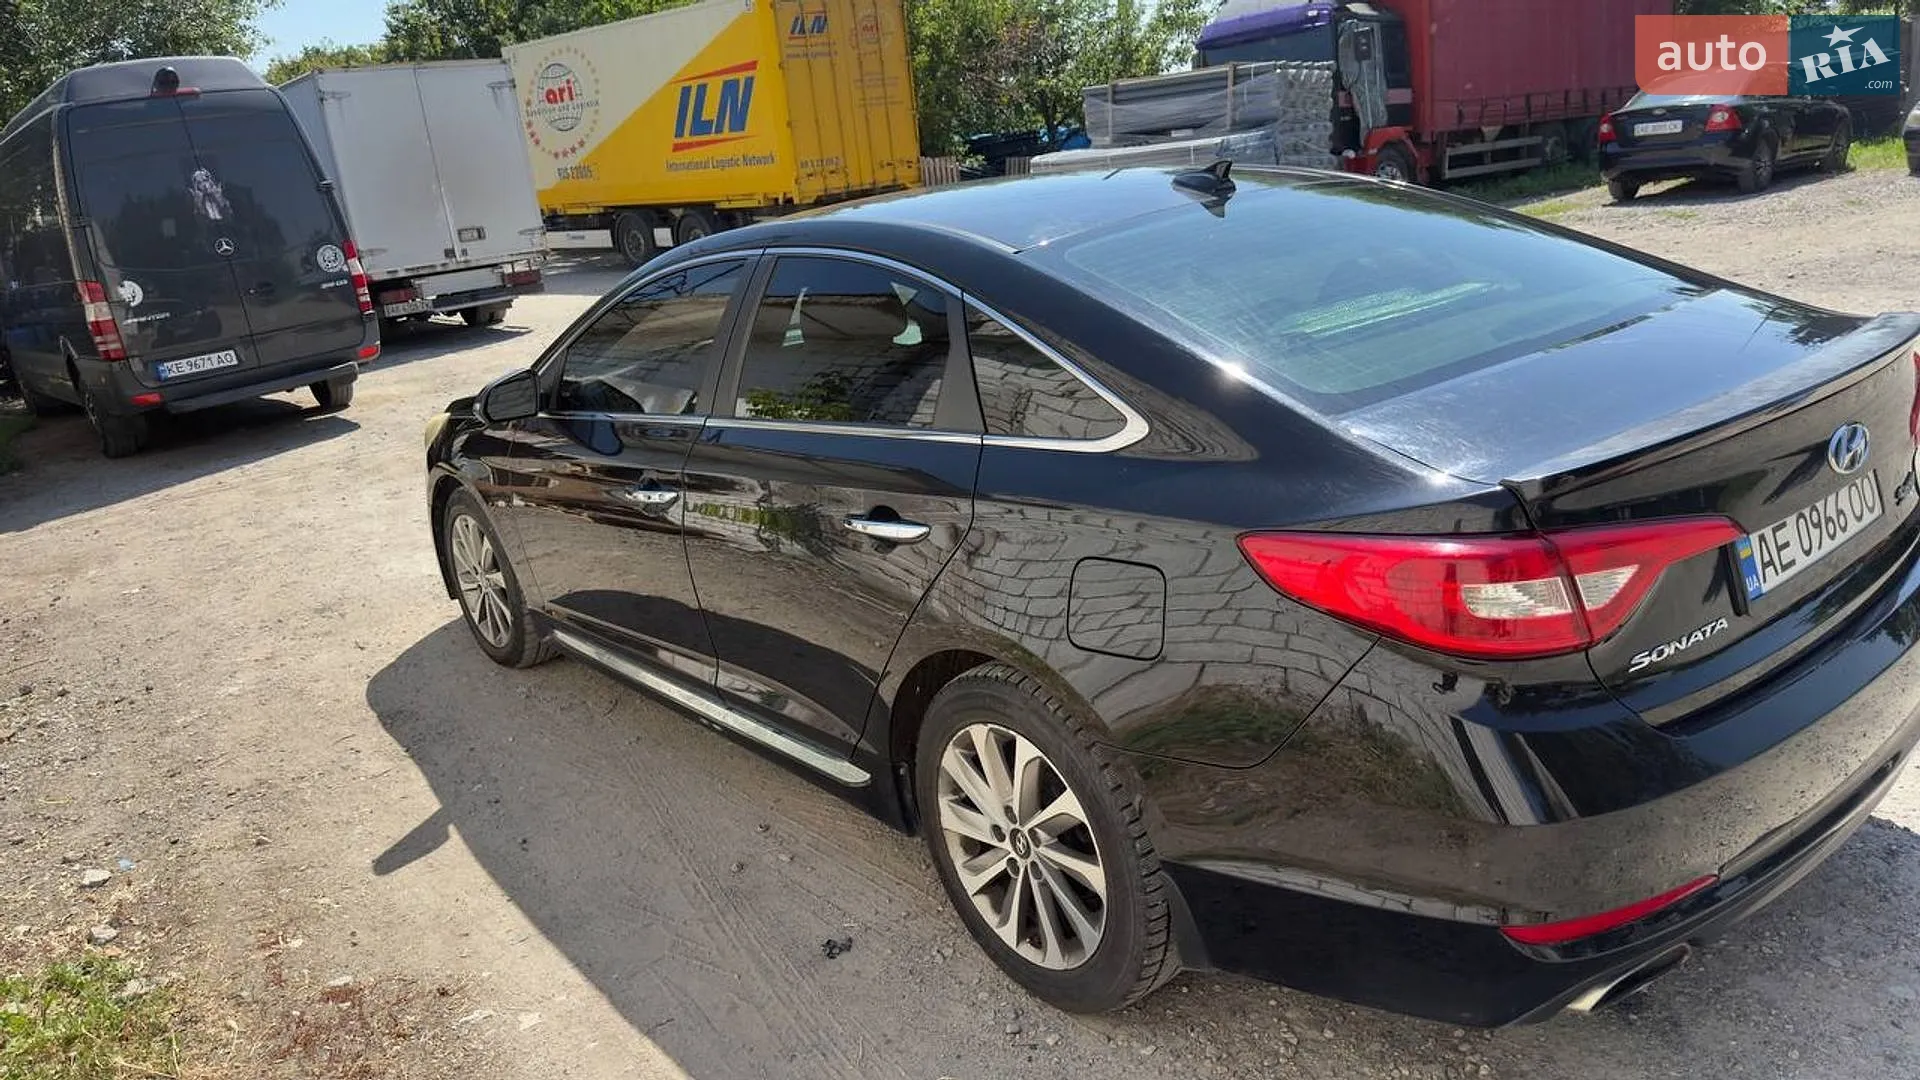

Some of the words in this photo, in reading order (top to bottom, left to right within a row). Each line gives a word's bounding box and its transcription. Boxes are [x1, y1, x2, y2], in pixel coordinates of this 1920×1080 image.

[545, 78, 575, 105] ari
[675, 76, 755, 138] ILN
[665, 156, 710, 170] International
[711, 154, 741, 171] Logistic
[743, 152, 776, 167] Network
[167, 360, 185, 375] KE
[186, 356, 214, 371] 9671
[217, 352, 234, 366] AO
[1758, 521, 1796, 585] AE
[1796, 492, 1848, 556] 0966
[1849, 475, 1876, 522] OO
[1746, 574, 1760, 593] UA
[1629, 617, 1729, 674] SONATA
